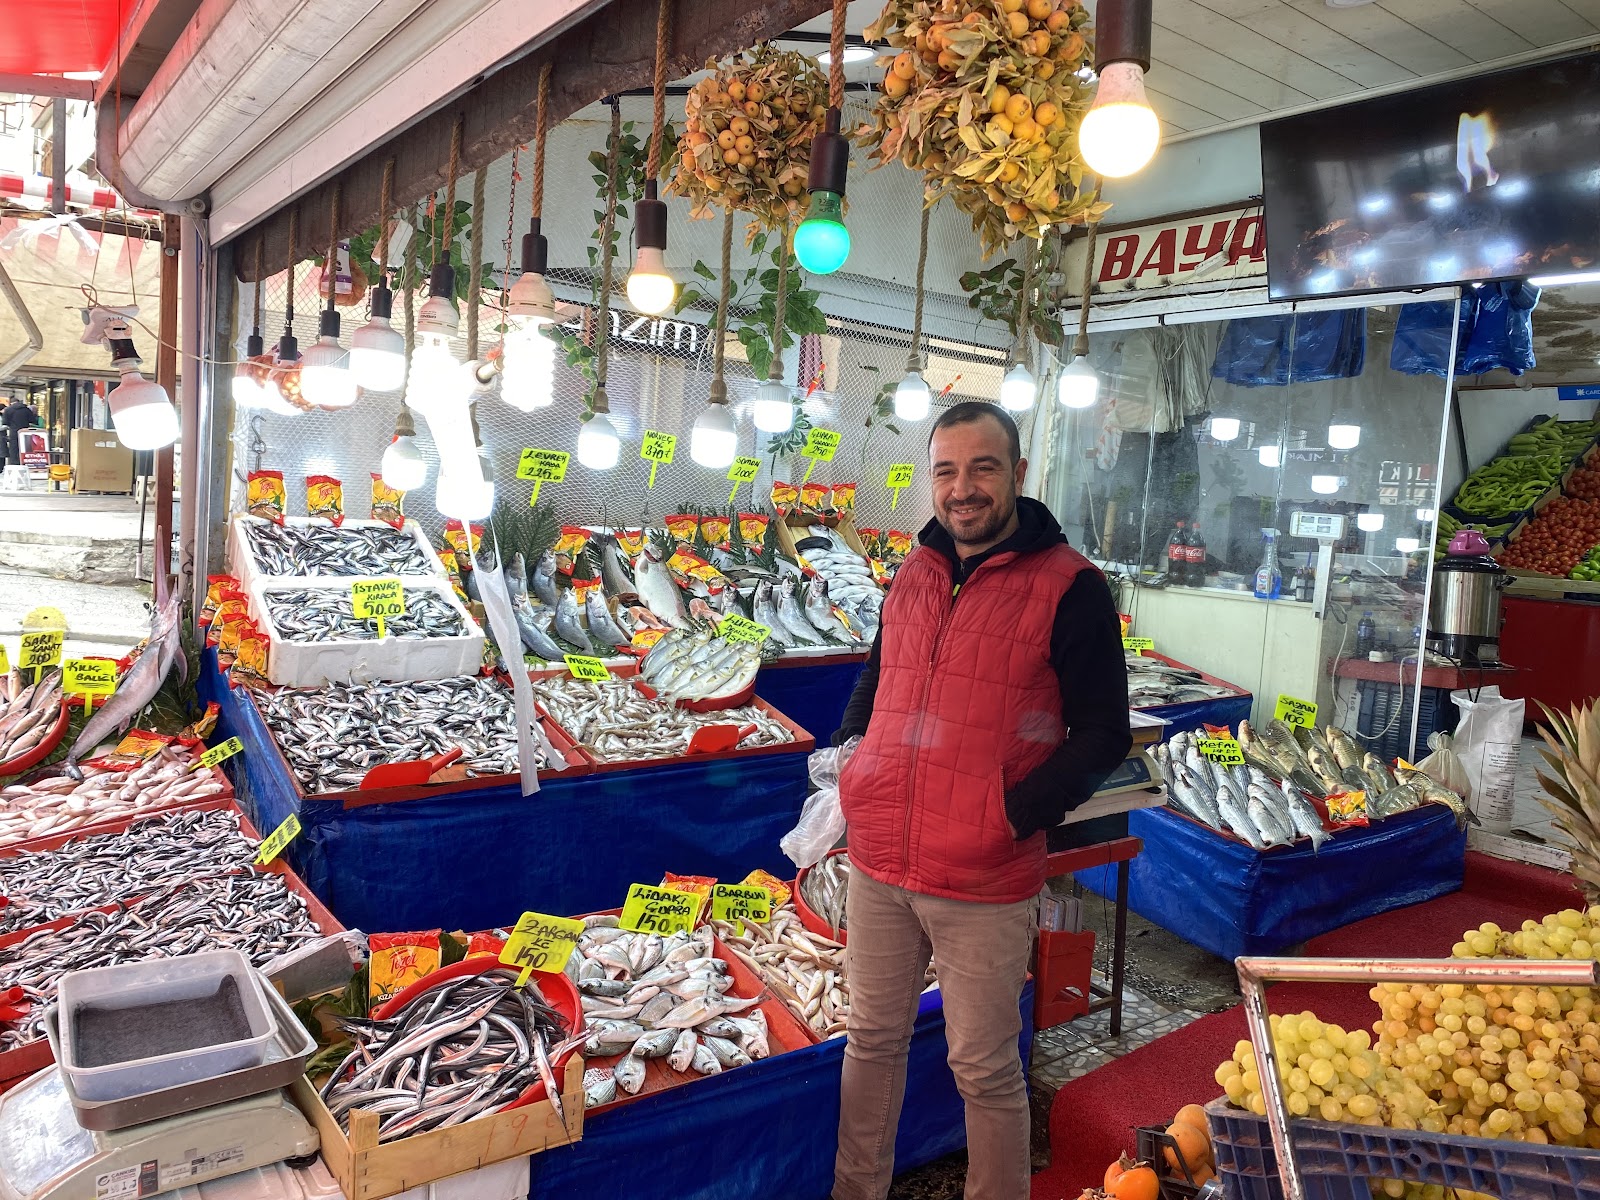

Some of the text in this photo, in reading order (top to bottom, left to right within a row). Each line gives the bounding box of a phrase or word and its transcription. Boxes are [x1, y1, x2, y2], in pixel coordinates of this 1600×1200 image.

[523, 450, 567, 464] LEVREK
[540, 460, 561, 468] KAYA
[736, 456, 761, 467] SOMON
[363, 601, 402, 616] 50.00
[723, 615, 767, 636] LÜFER
[1280, 697, 1316, 713] SAZAN
[1283, 712, 1305, 725] 100
[716, 886, 766, 900] BARBUN
[513, 945, 548, 968] 150
